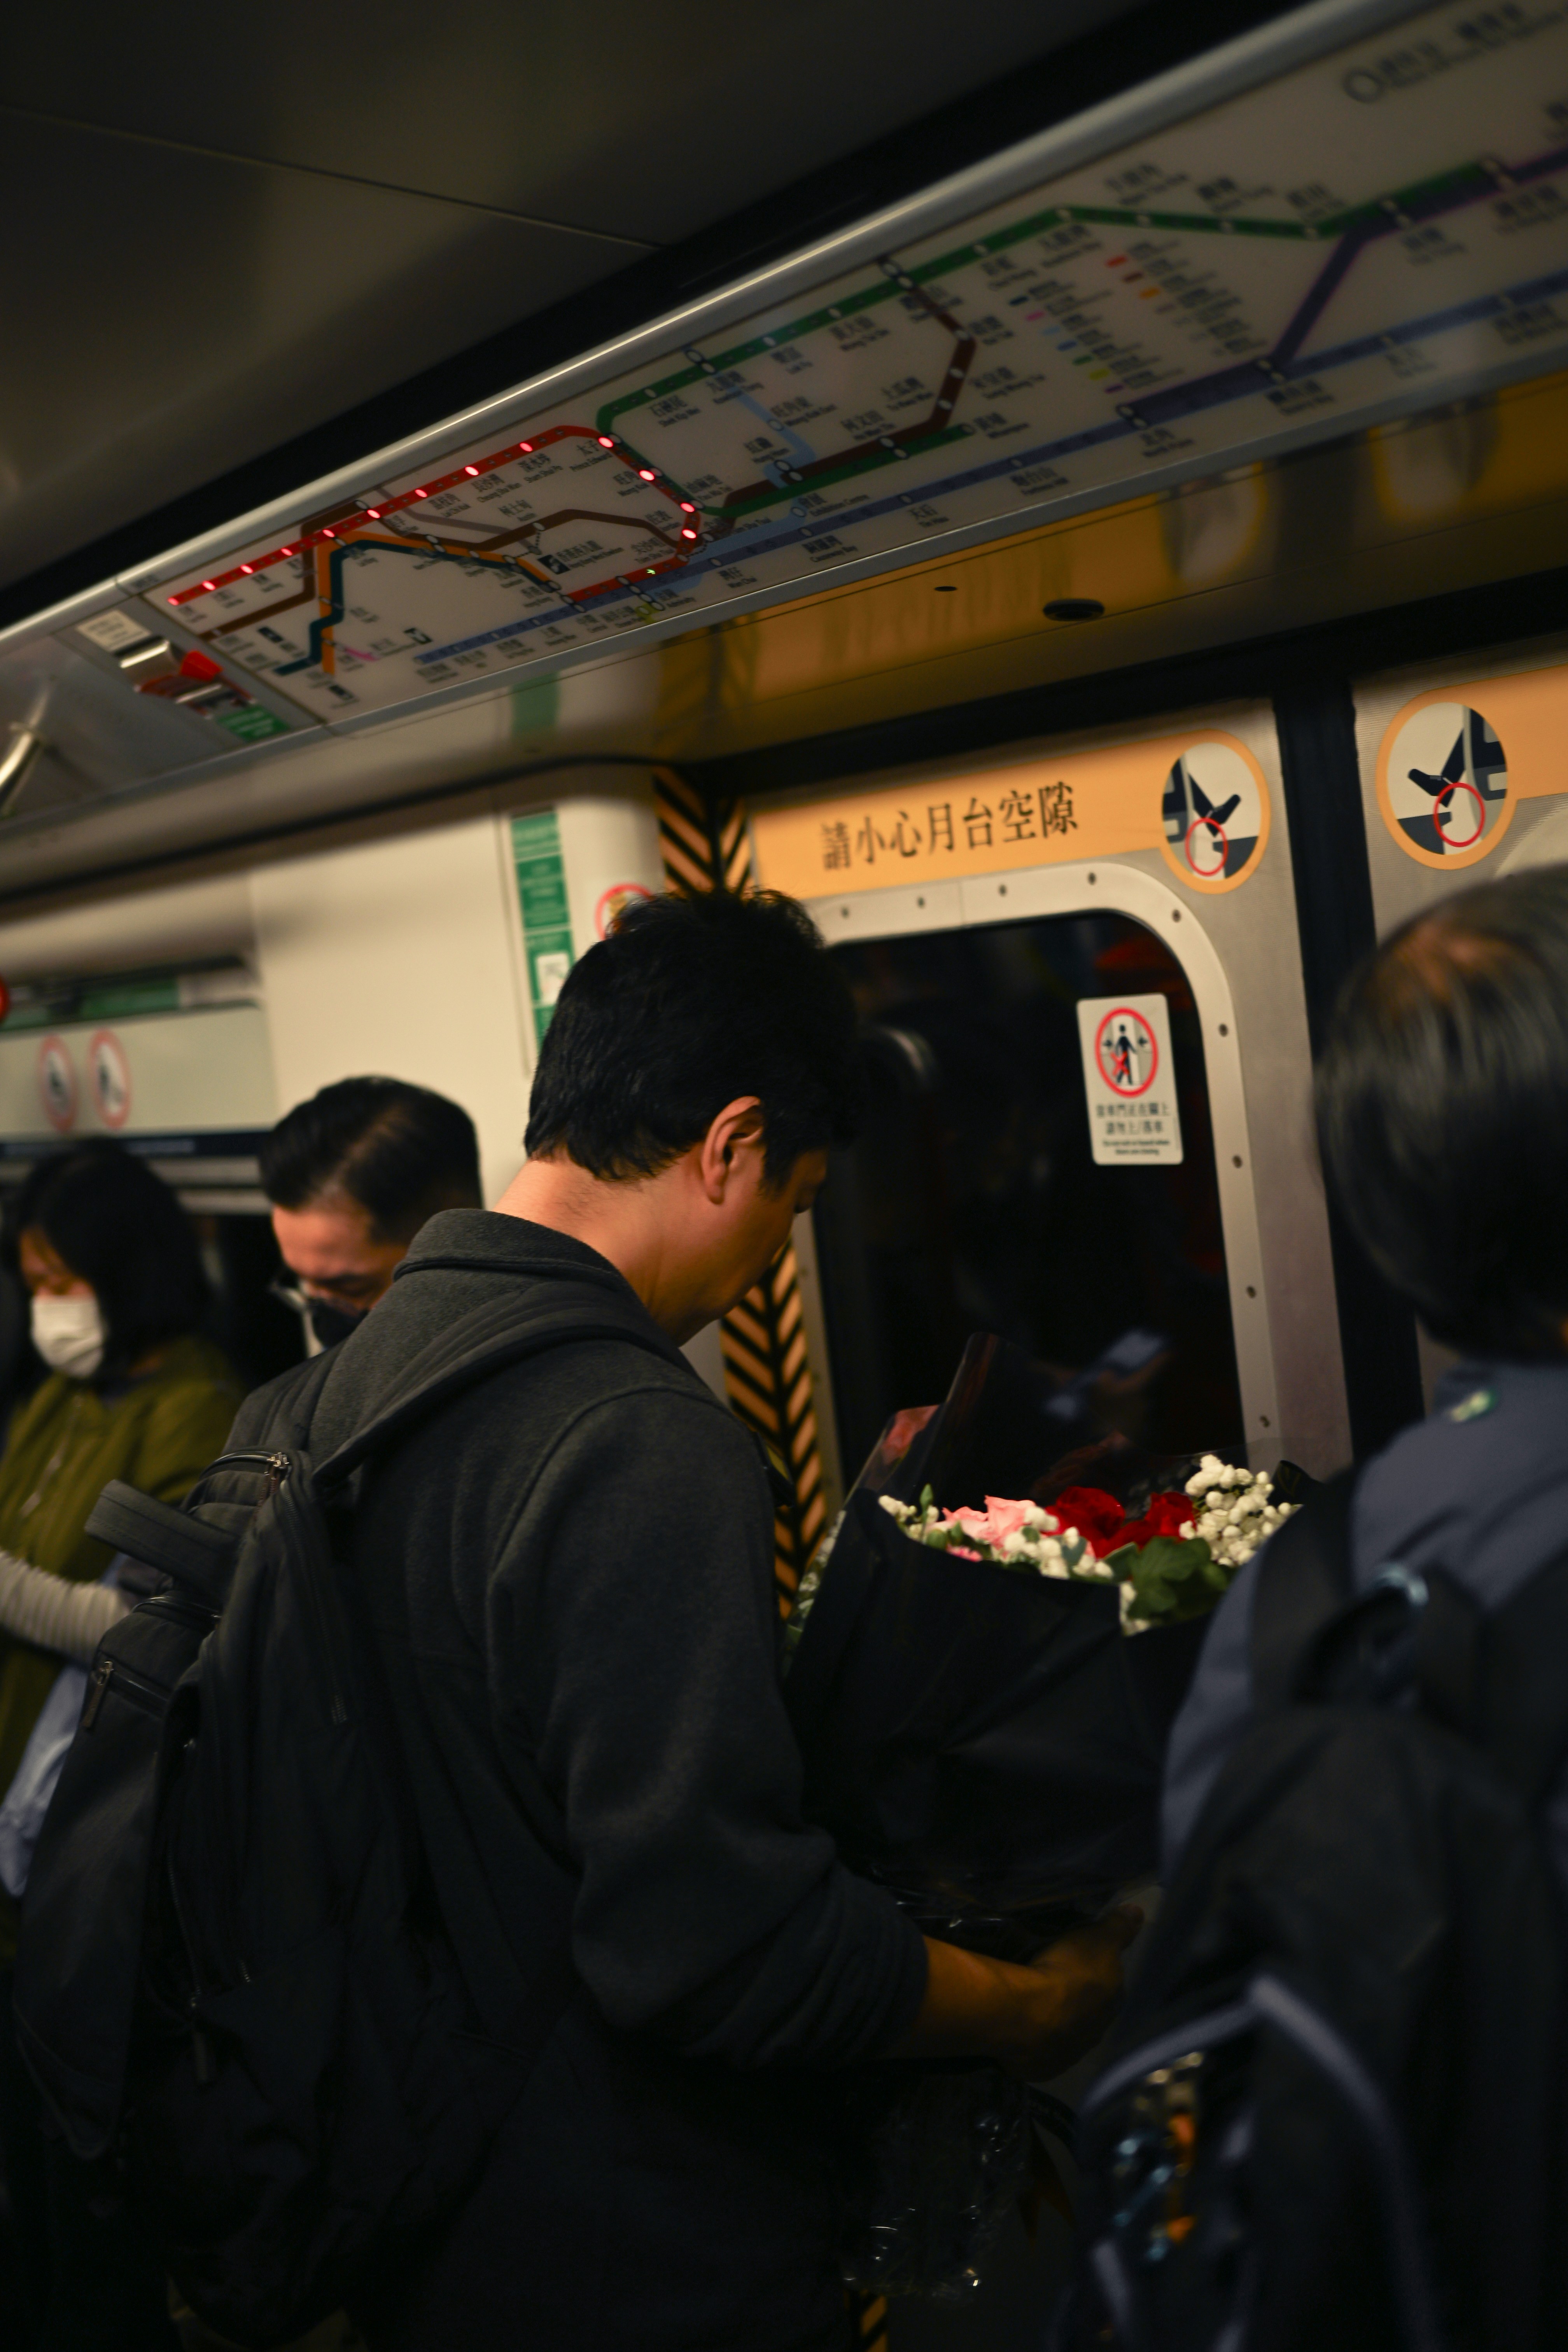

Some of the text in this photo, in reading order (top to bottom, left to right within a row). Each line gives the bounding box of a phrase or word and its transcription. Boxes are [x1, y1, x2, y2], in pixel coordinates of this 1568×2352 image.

[820, 782, 1078, 870] 請小心月台空隙
